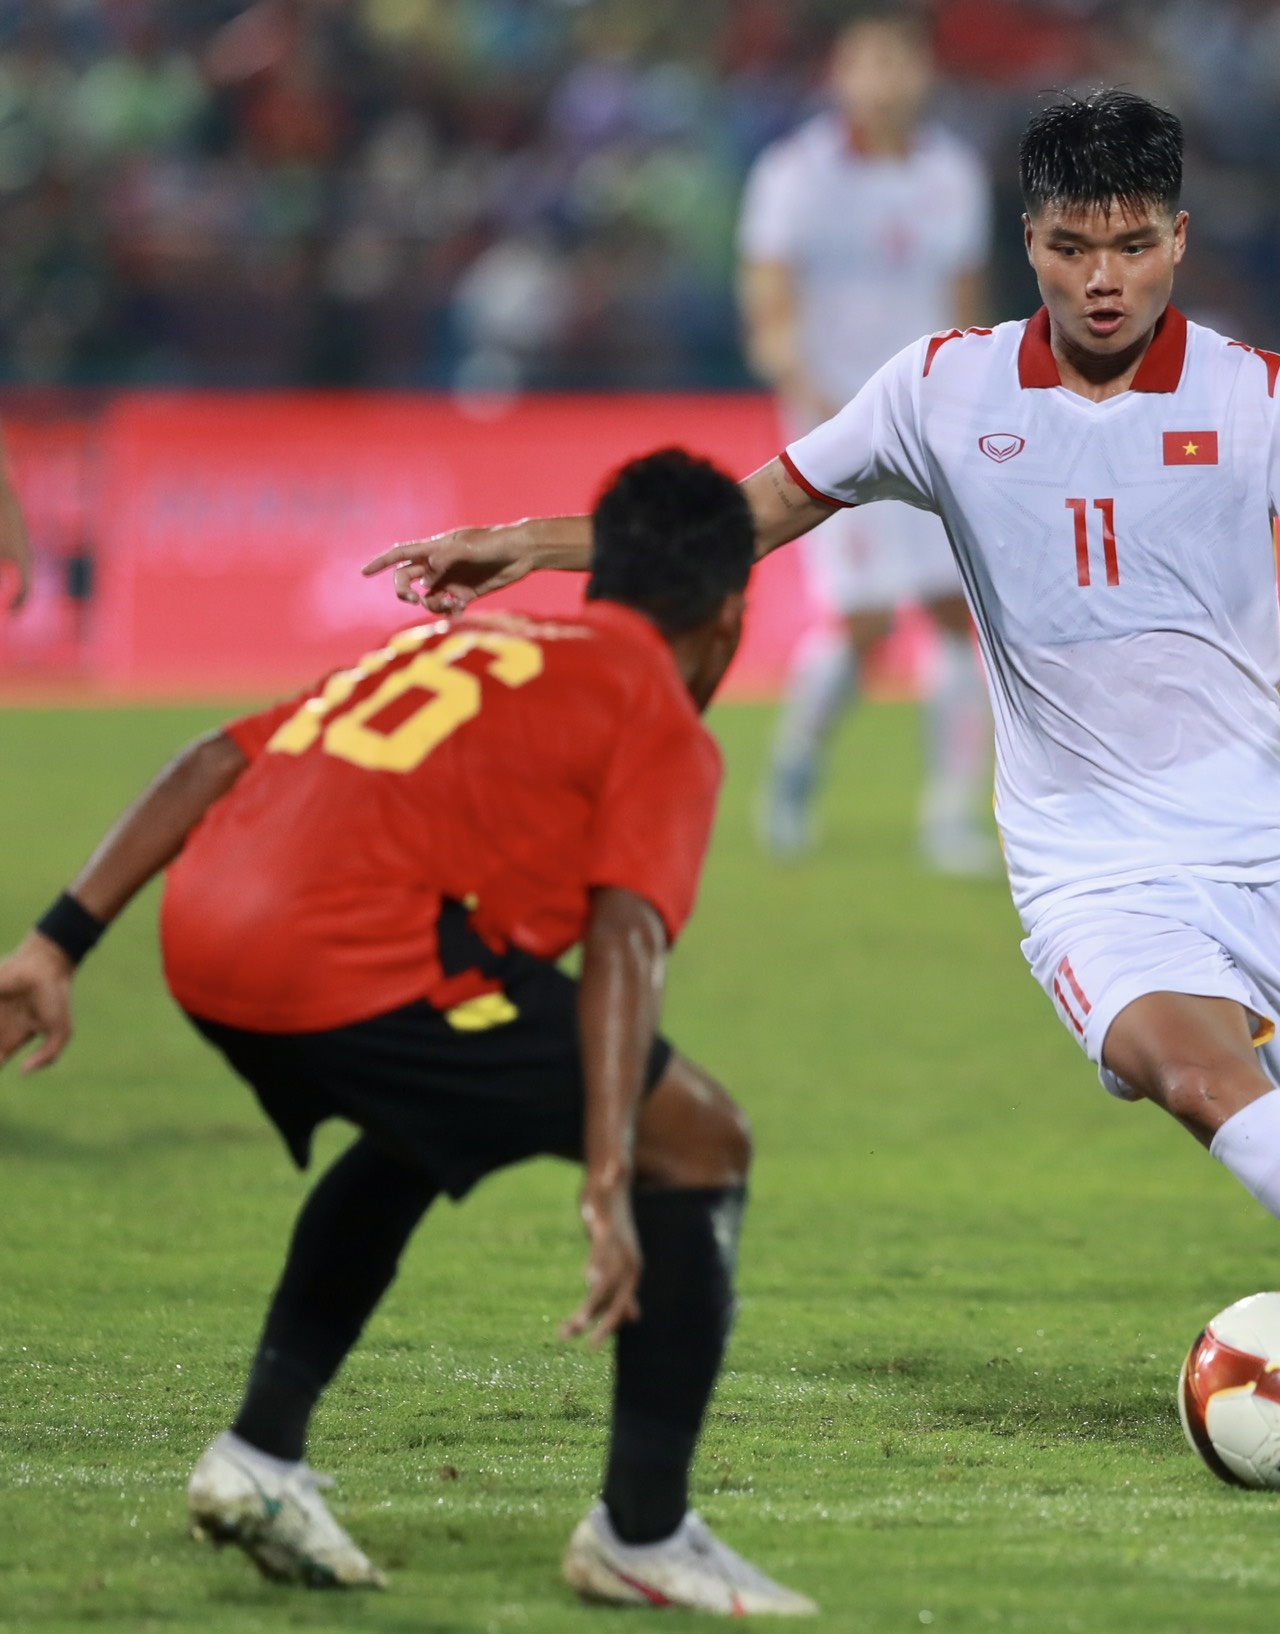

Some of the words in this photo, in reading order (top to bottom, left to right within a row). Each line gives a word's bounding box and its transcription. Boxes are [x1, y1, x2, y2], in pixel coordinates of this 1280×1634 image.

[1064, 498, 1119, 587] 11
[265, 619, 544, 774] 16
[1053, 955, 1092, 1036] 11
